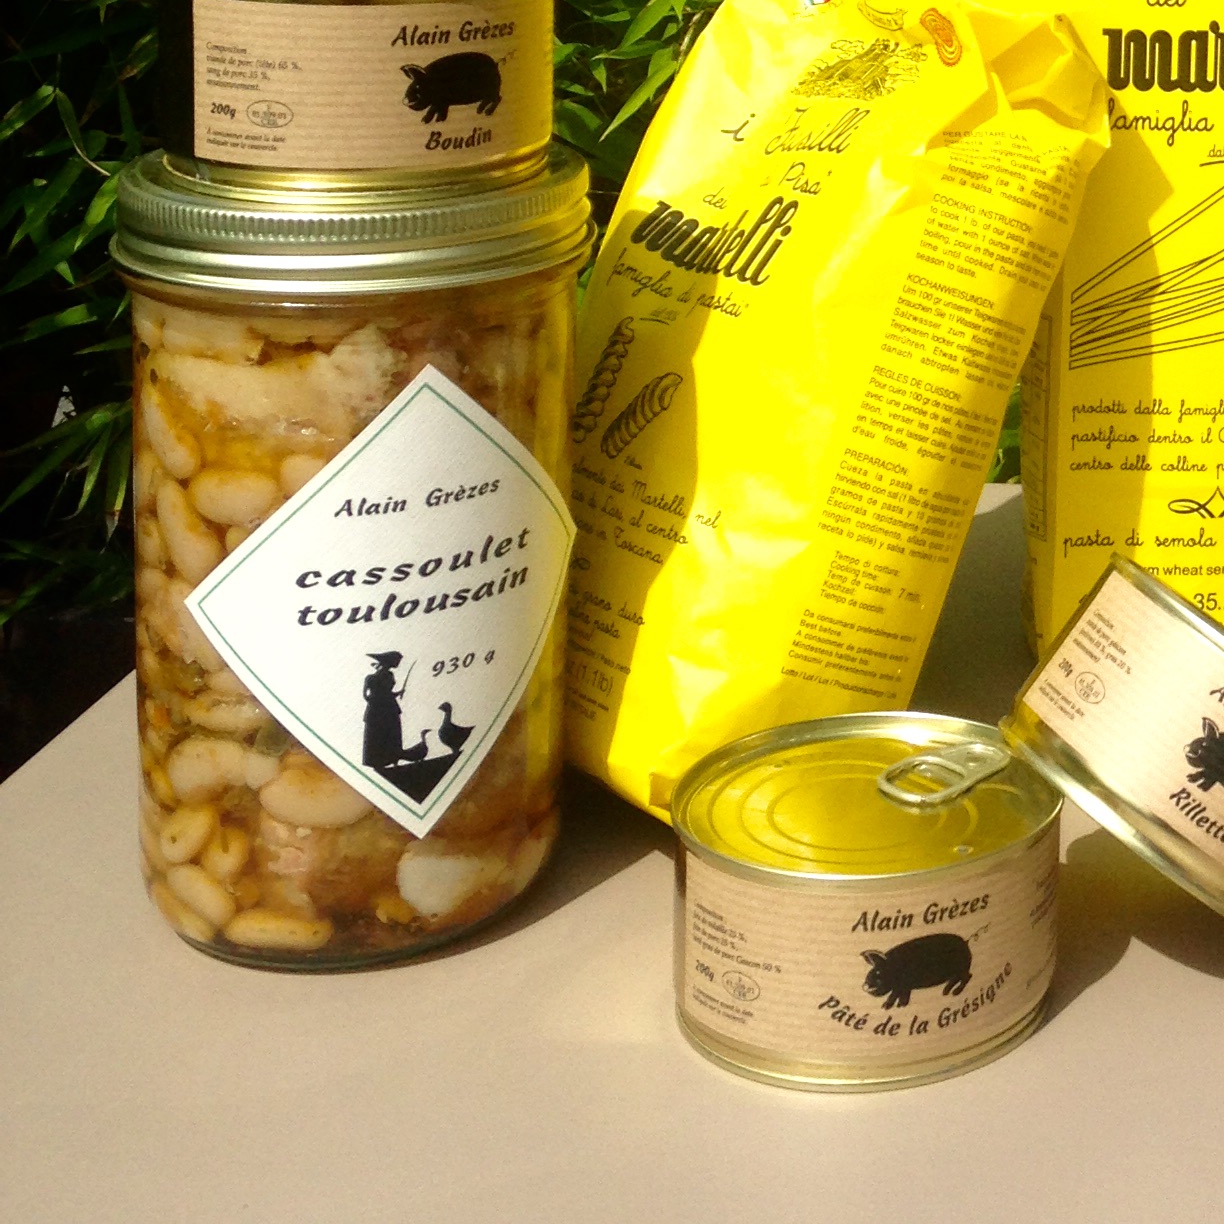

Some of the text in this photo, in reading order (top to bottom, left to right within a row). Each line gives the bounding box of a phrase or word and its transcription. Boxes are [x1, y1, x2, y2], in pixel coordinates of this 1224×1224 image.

[391, 20, 516, 47] Alain Grèzes
[210, 102, 237, 119] 200g
[425, 127, 493, 151] Boudin
[703, 187, 727, 210] dei
[933, 193, 976, 214] COOKING
[630, 196, 799, 286] martelli
[920, 239, 939, 252] time
[606, 247, 673, 297] famiglia
[916, 252, 955, 271] season to
[902, 284, 917, 296] Um
[947, 327, 966, 338] zum
[880, 343, 913, 360] danach
[910, 378, 922, 389] DE
[1071, 399, 1127, 422] prodotti
[1134, 397, 1171, 416] dalla
[1071, 426, 1140, 451] pastificio
[1148, 428, 1194, 445] dentro
[1201, 426, 1213, 445] il
[1069, 457, 1114, 472] centro
[1120, 454, 1153, 471] delle
[1160, 456, 1208, 472] colline
[334, 479, 501, 519] Alain Grèzes
[629, 509, 645, 528] al
[646, 523, 688, 545] centro
[695, 510, 721, 528] nel
[1063, 529, 1115, 557] pasta
[1125, 528, 1145, 547] di
[1154, 527, 1217, 548] semola
[295, 527, 531, 590] cassoulet
[1163, 564, 1203, 576] wheat
[297, 565, 529, 627] toulousain
[432, 649, 496, 678] 930 g
[851, 893, 991, 933] Alain Grèzes
[818, 962, 1013, 1037] Pâté de la Grésigne
